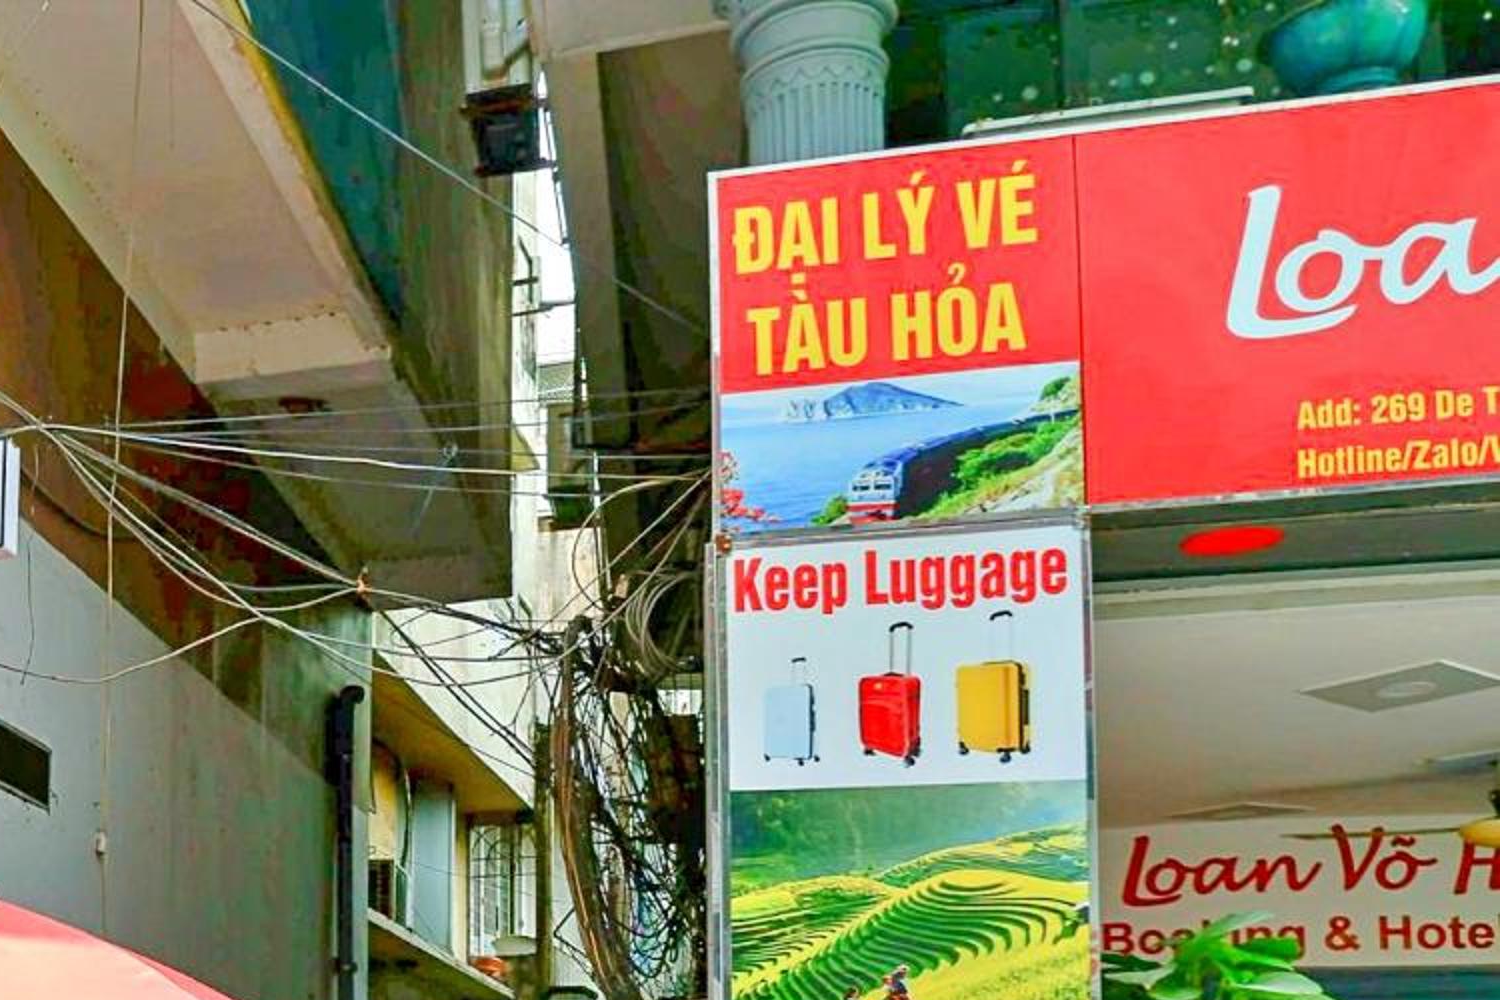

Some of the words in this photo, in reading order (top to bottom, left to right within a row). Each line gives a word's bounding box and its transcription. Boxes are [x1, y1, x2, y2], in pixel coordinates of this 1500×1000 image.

[732, 198, 839, 285] ĐẠI
[862, 171, 934, 259] LÝ
[956, 160, 1038, 249] VÉ
[747, 289, 868, 376] TÀU
[891, 262, 1027, 361] HỎA
[1297, 398, 1362, 430] Add:
[1371, 392, 1425, 424] 269
[1435, 390, 1473, 420] De
[733, 555, 848, 615] Keep
[865, 547, 1068, 609] Luggage
[1122, 834, 1322, 907] Loan
[1332, 824, 1437, 891] Võ
[1324, 916, 1360, 951] &
